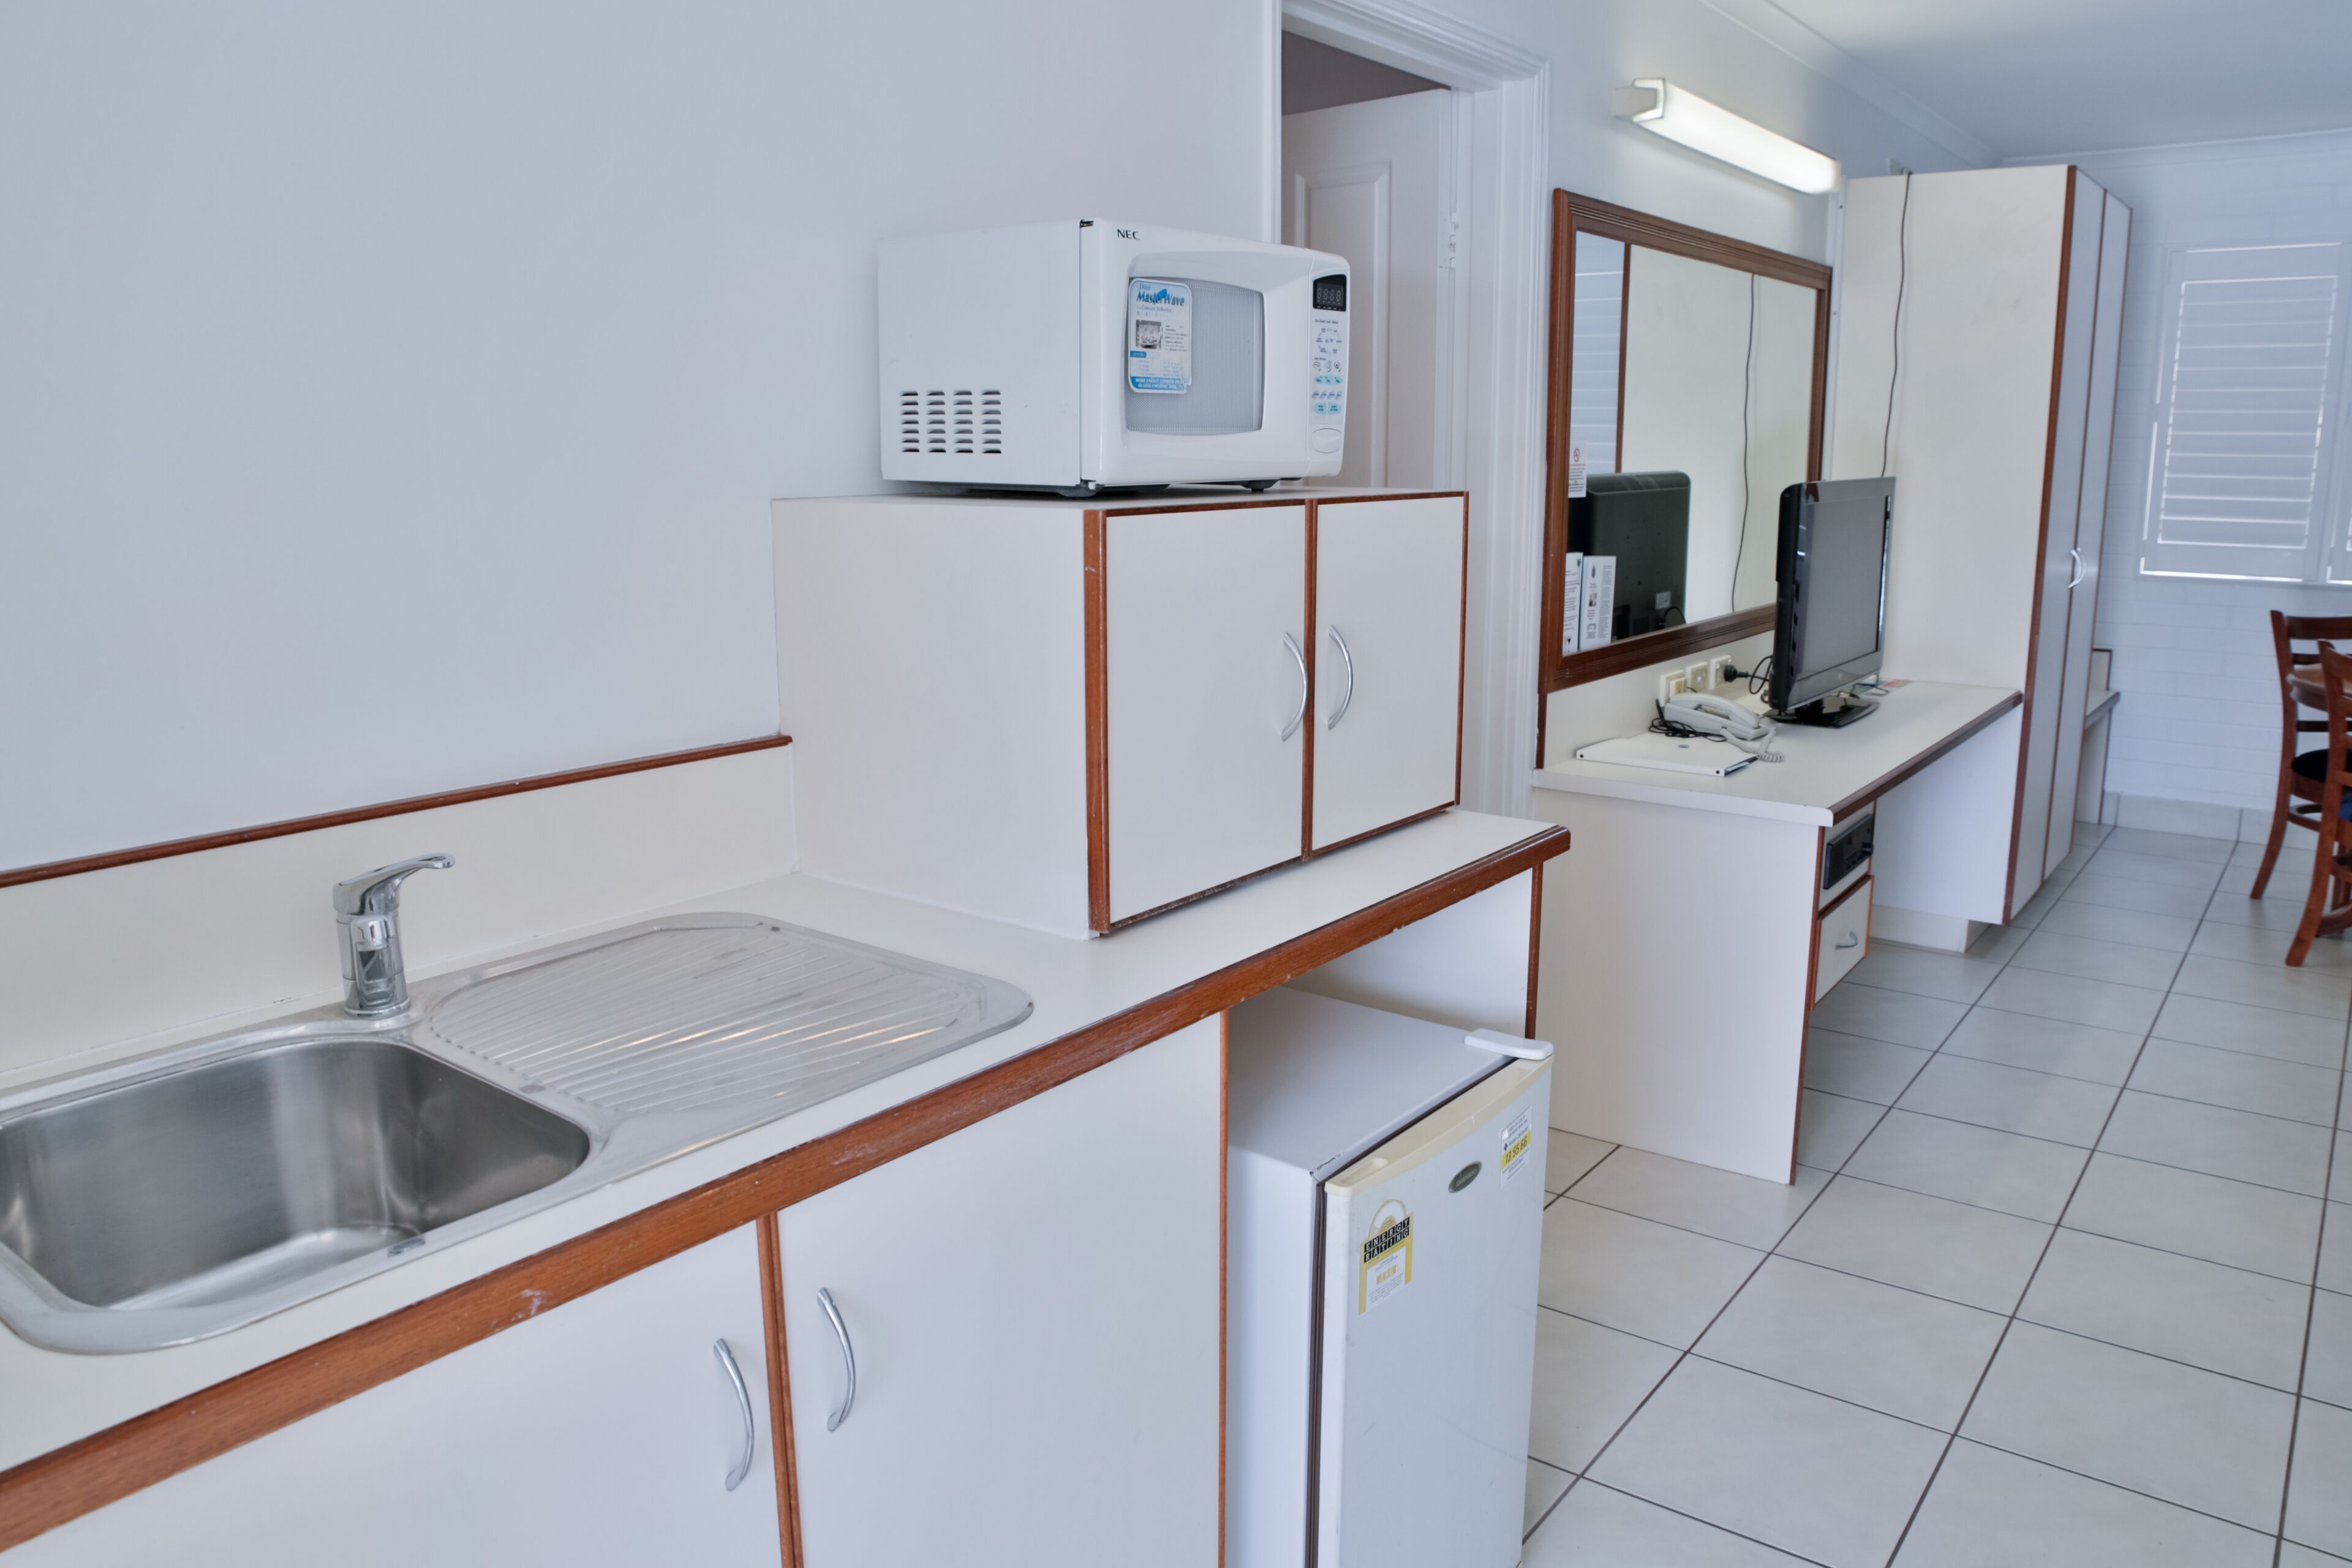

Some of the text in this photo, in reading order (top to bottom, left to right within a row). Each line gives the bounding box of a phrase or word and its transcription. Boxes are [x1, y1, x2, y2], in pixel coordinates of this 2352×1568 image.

[1117, 229, 1140, 240] NEC
[1506, 1150, 1511, 1164] 13
[1513, 1142, 1520, 1158] 55
[1520, 1136, 1528, 1150] 66
[1365, 1229, 1408, 1262] RATING
[1366, 1218, 1408, 1251] ENERGY
